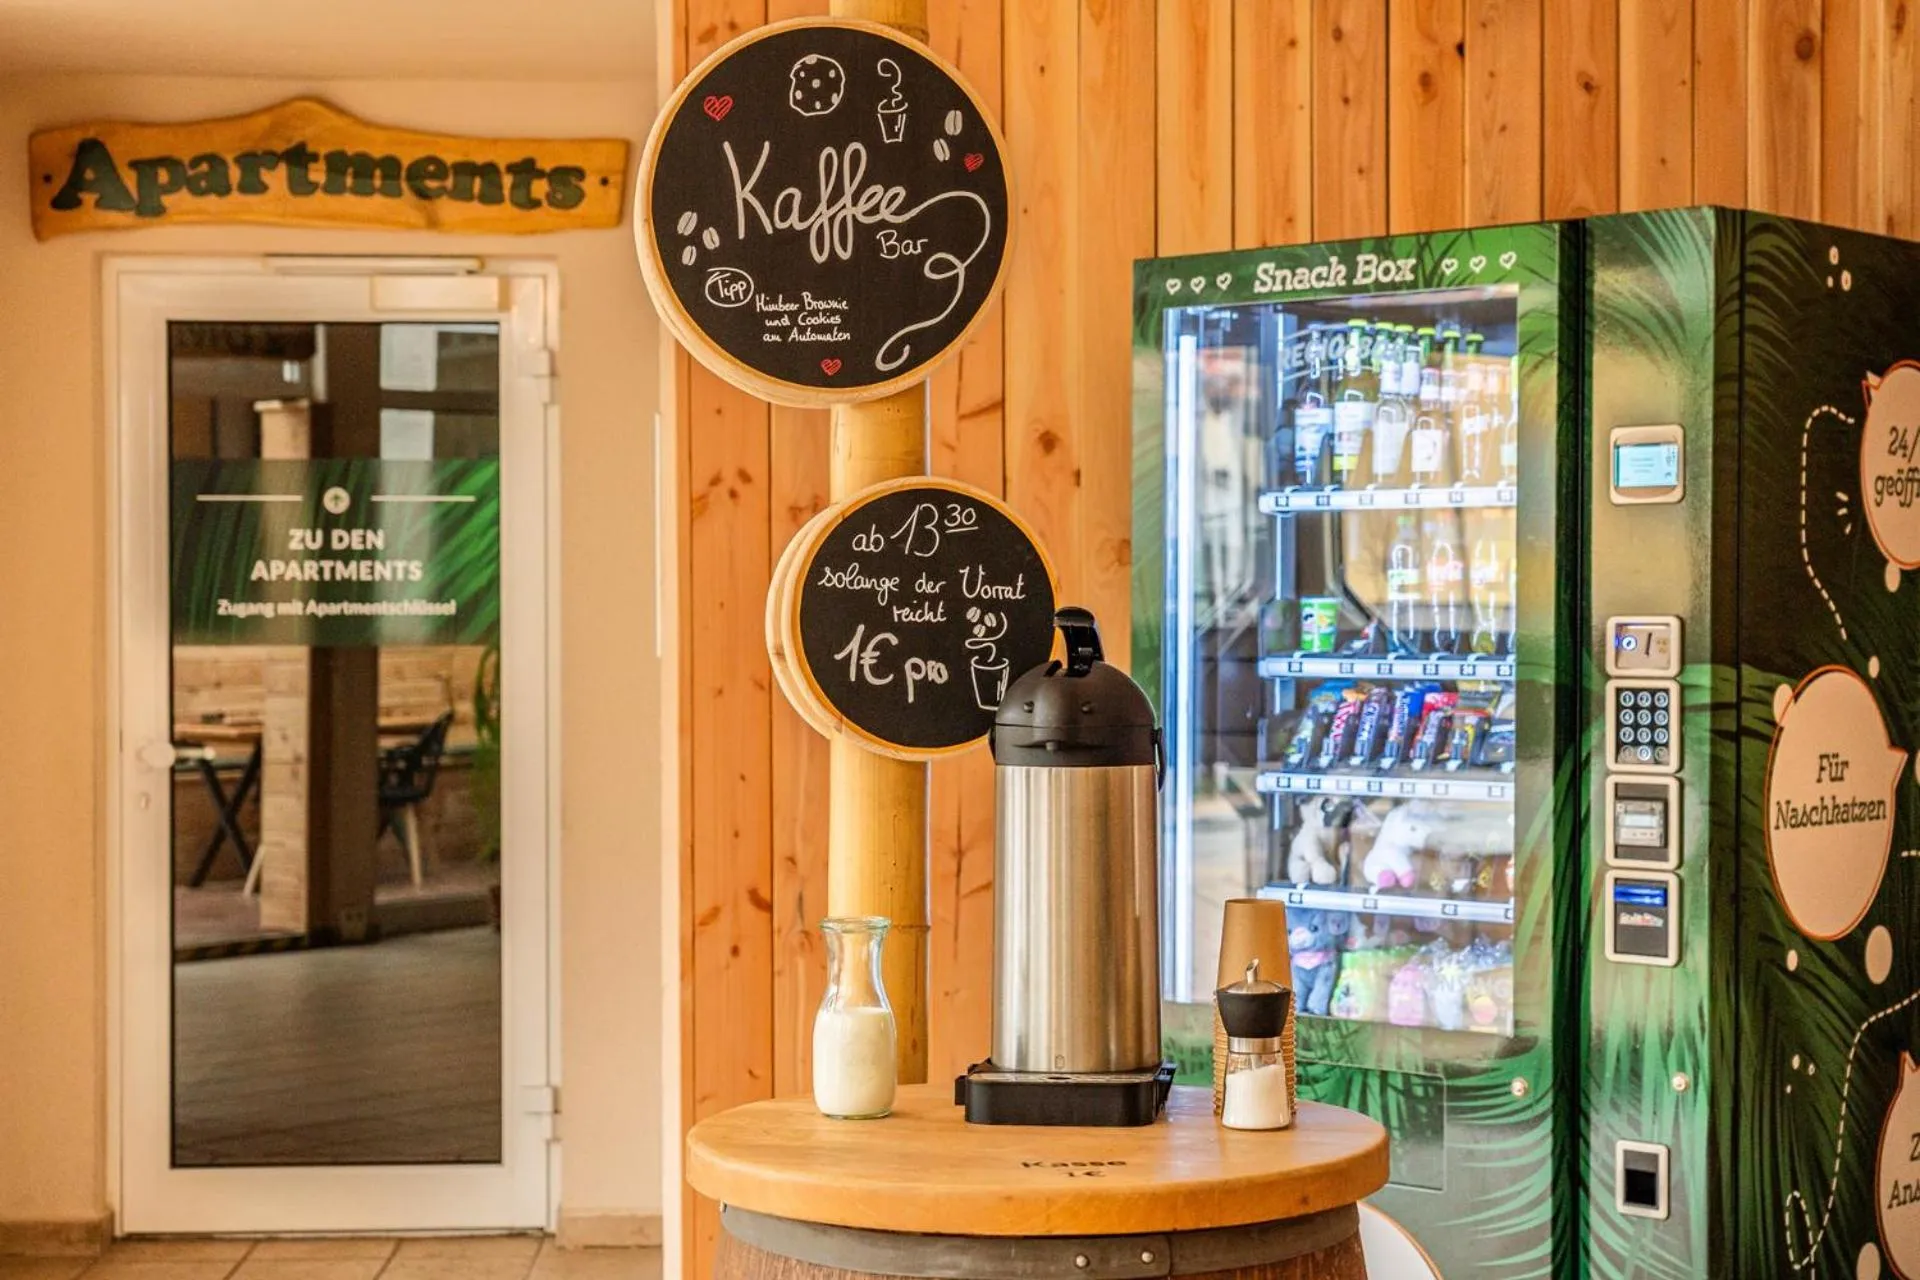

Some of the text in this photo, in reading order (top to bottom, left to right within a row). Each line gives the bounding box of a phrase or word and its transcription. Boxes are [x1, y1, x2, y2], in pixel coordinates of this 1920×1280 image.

[50, 138, 588, 219] Apartments
[722, 140, 912, 264] Kaffee
[876, 229, 929, 259] Bar
[711, 272, 748, 301] Tipp
[1253, 253, 1417, 294] Snack Box
[755, 291, 849, 312] Himbeer Brownie
[764, 311, 842, 327] und Cookies
[762, 326, 851, 342] am Automaten
[288, 528, 385, 550] ZU DEN
[852, 524, 885, 552] ab
[250, 560, 423, 581] APARTMENTS
[818, 562, 1026, 606] solange der Vorrat
[216, 598, 275, 619] Zugang
[277, 599, 304, 616] mit
[892, 600, 947, 623] reicht
[834, 624, 949, 704] 1€ pro
[1816, 752, 1850, 783] Für
[1774, 795, 1887, 830] Naschkatzen
[1021, 1160, 1127, 1169] Kasse
